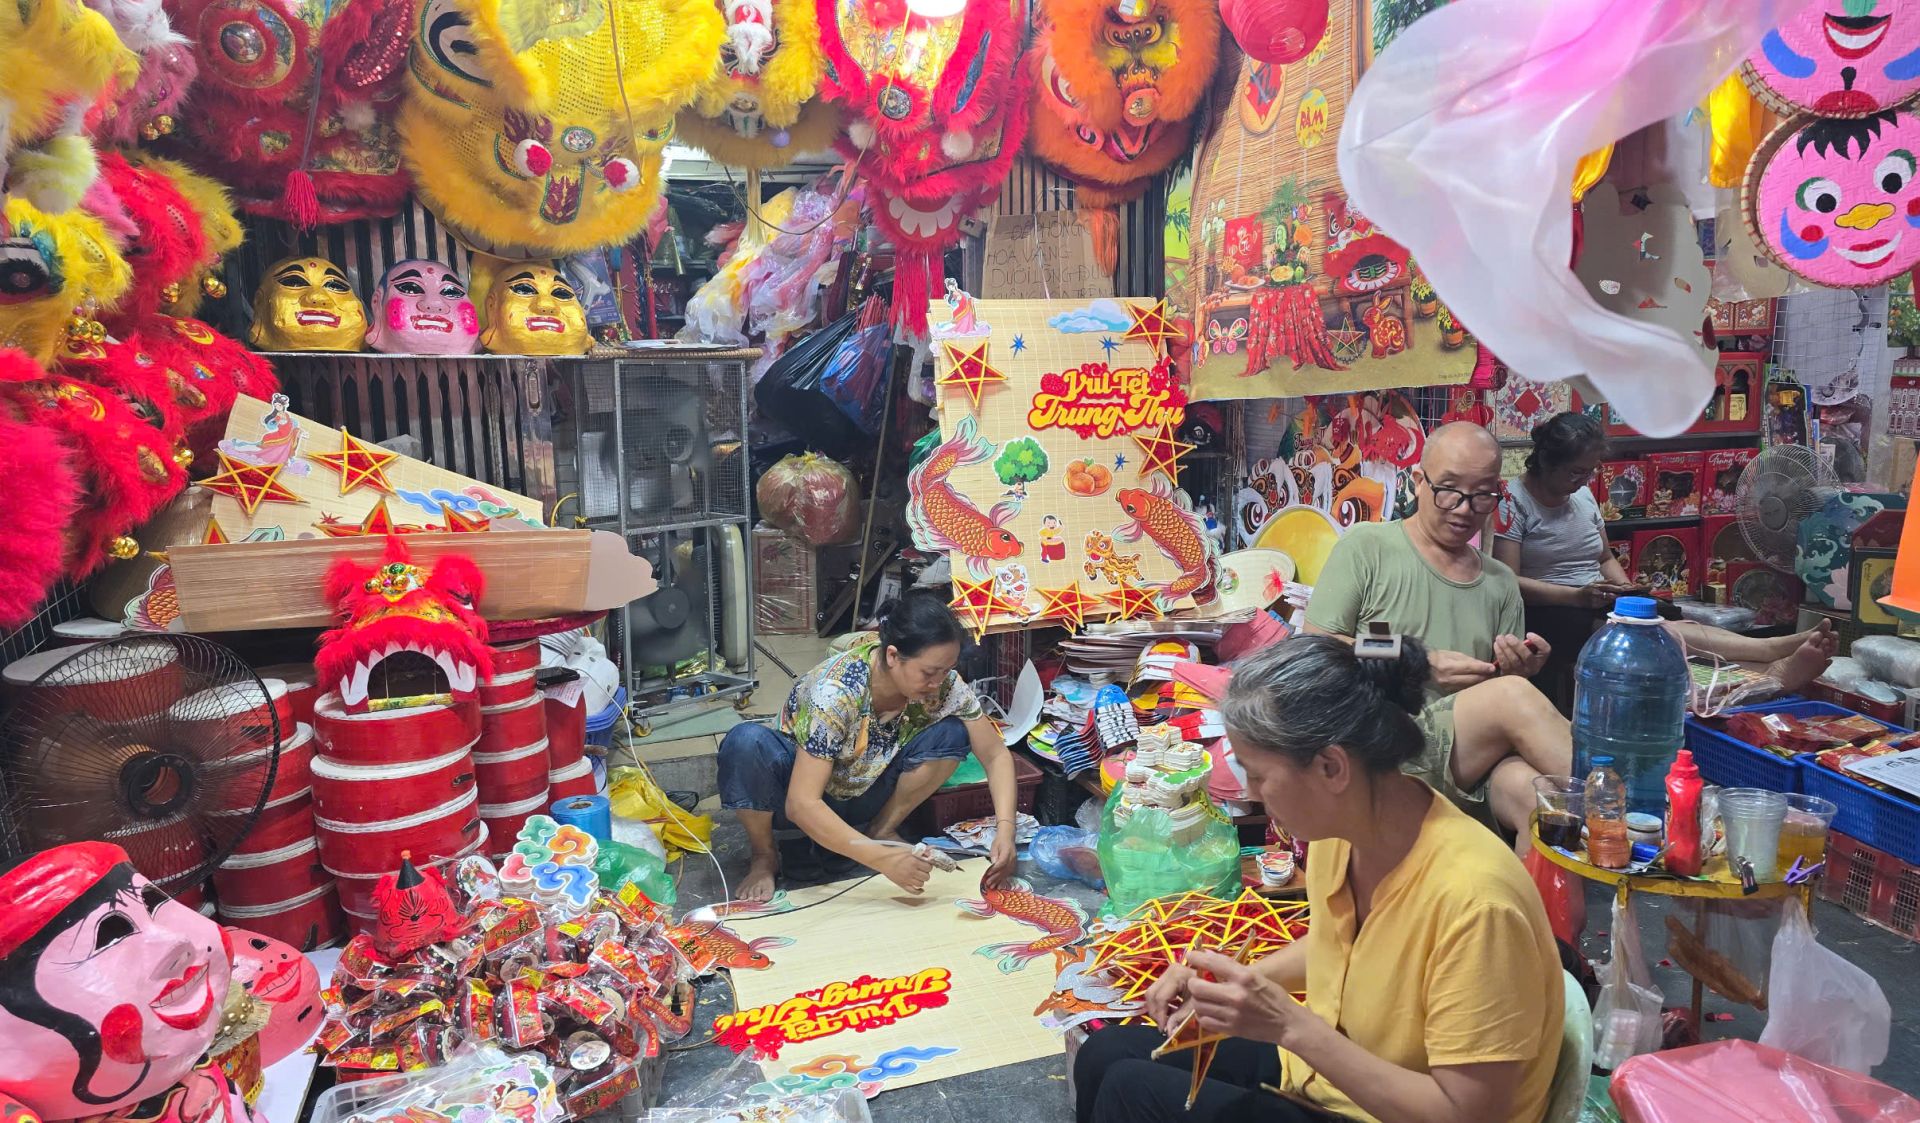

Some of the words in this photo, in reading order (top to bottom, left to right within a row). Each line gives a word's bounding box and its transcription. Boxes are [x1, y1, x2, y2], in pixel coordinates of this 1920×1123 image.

[1063, 371, 1112, 401] Vui
[1112, 368, 1151, 394] Tết
[1029, 393, 1121, 437] Trung
[1124, 390, 1184, 427] Thu
[818, 967, 951, 1007] Trung
[716, 997, 817, 1035] Thu
[845, 996, 917, 1022] Vui
[781, 1015, 843, 1040] Tết
